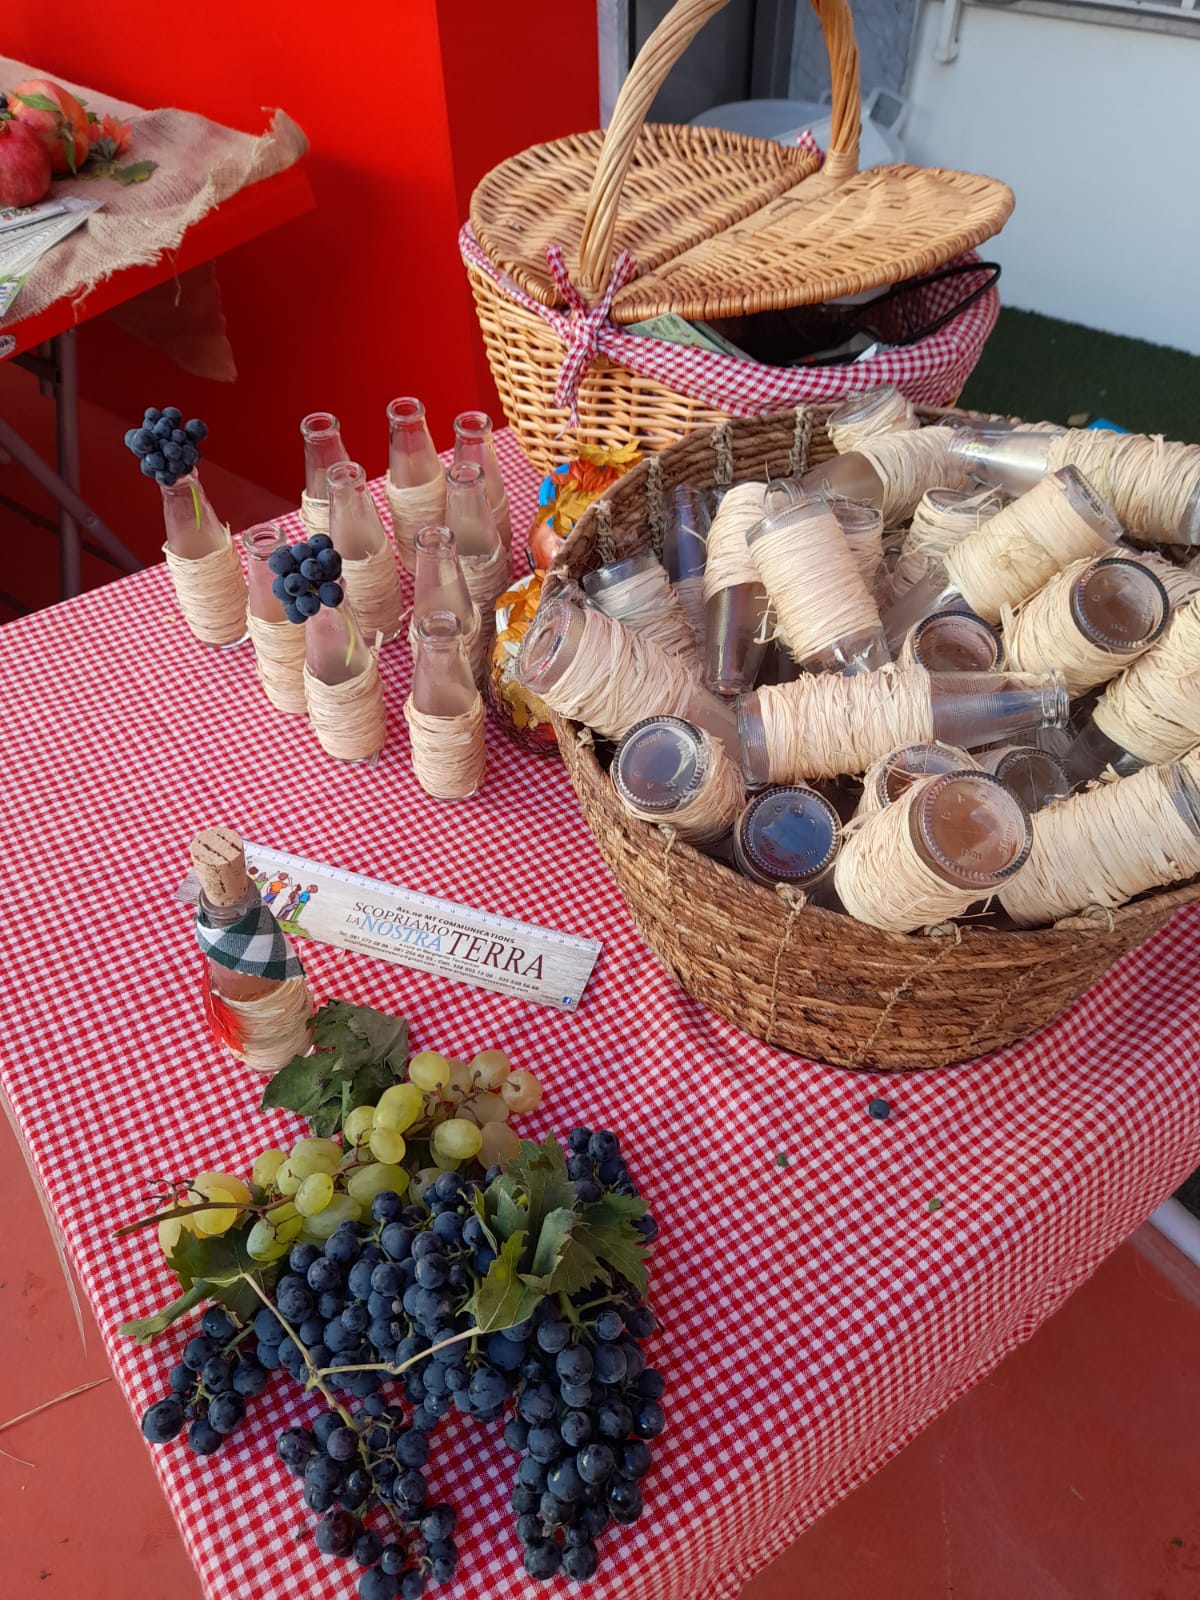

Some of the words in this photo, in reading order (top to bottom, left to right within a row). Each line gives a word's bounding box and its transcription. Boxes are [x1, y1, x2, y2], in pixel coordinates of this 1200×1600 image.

[353, 901, 450, 936] SCOPRIAMO
[424, 913, 438, 923] MT
[439, 918, 516, 944] COMMUNICATIONS
[345, 913, 360, 926] LA
[359, 914, 442, 952] NOSTRA
[446, 930, 543, 980] TERRA
